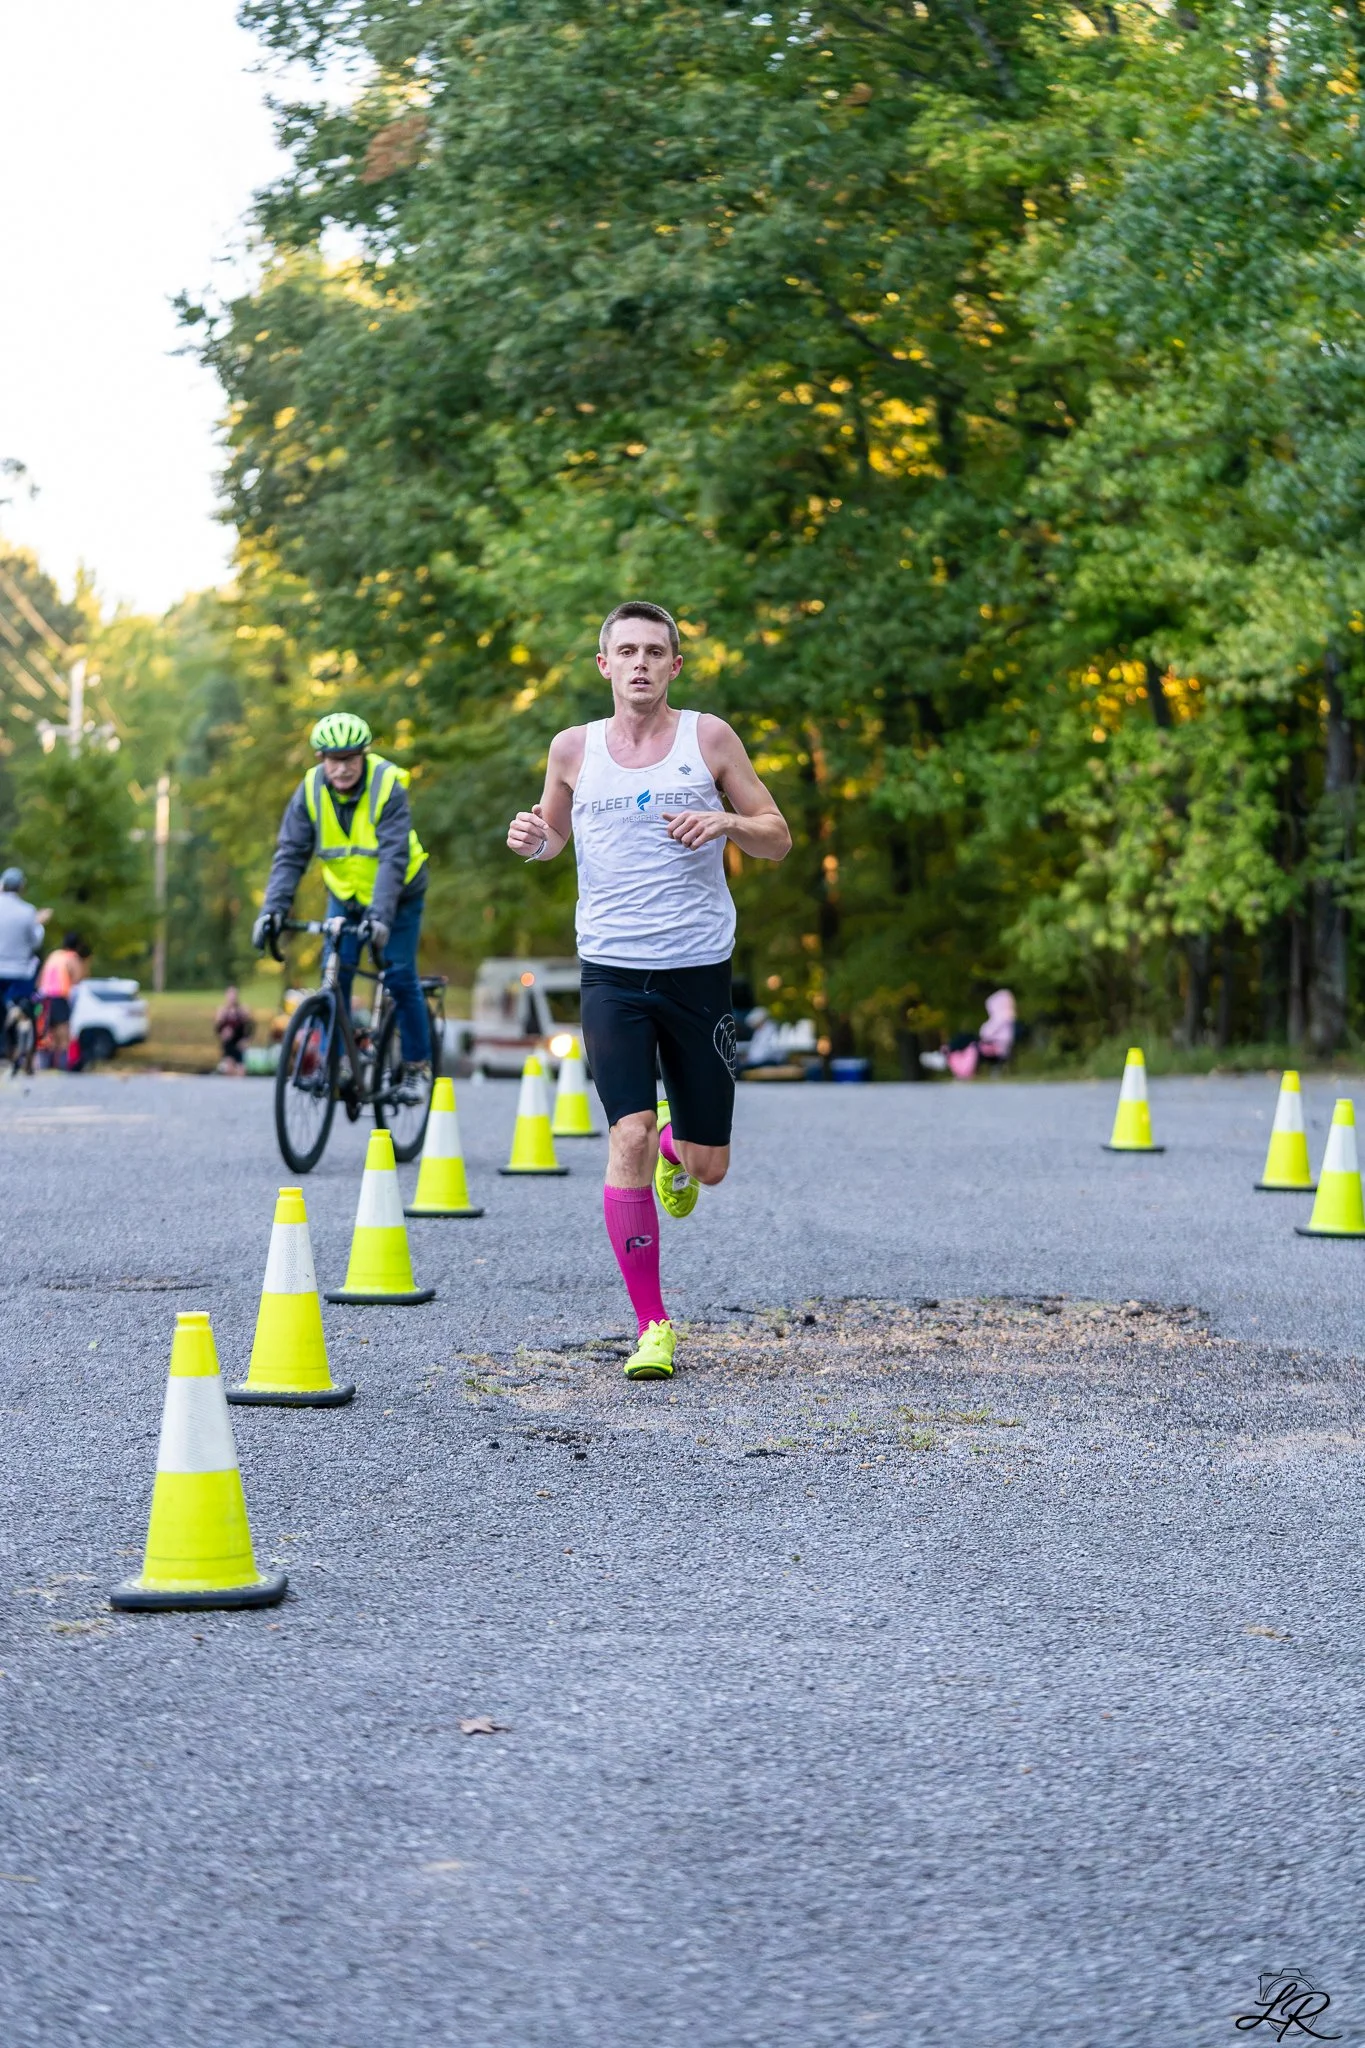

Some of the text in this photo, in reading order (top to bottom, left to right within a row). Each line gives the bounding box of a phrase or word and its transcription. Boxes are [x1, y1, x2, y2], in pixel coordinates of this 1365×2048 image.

[591, 792, 692, 813] FLEET FEET
[622, 813, 660, 824] MEMPHIS
